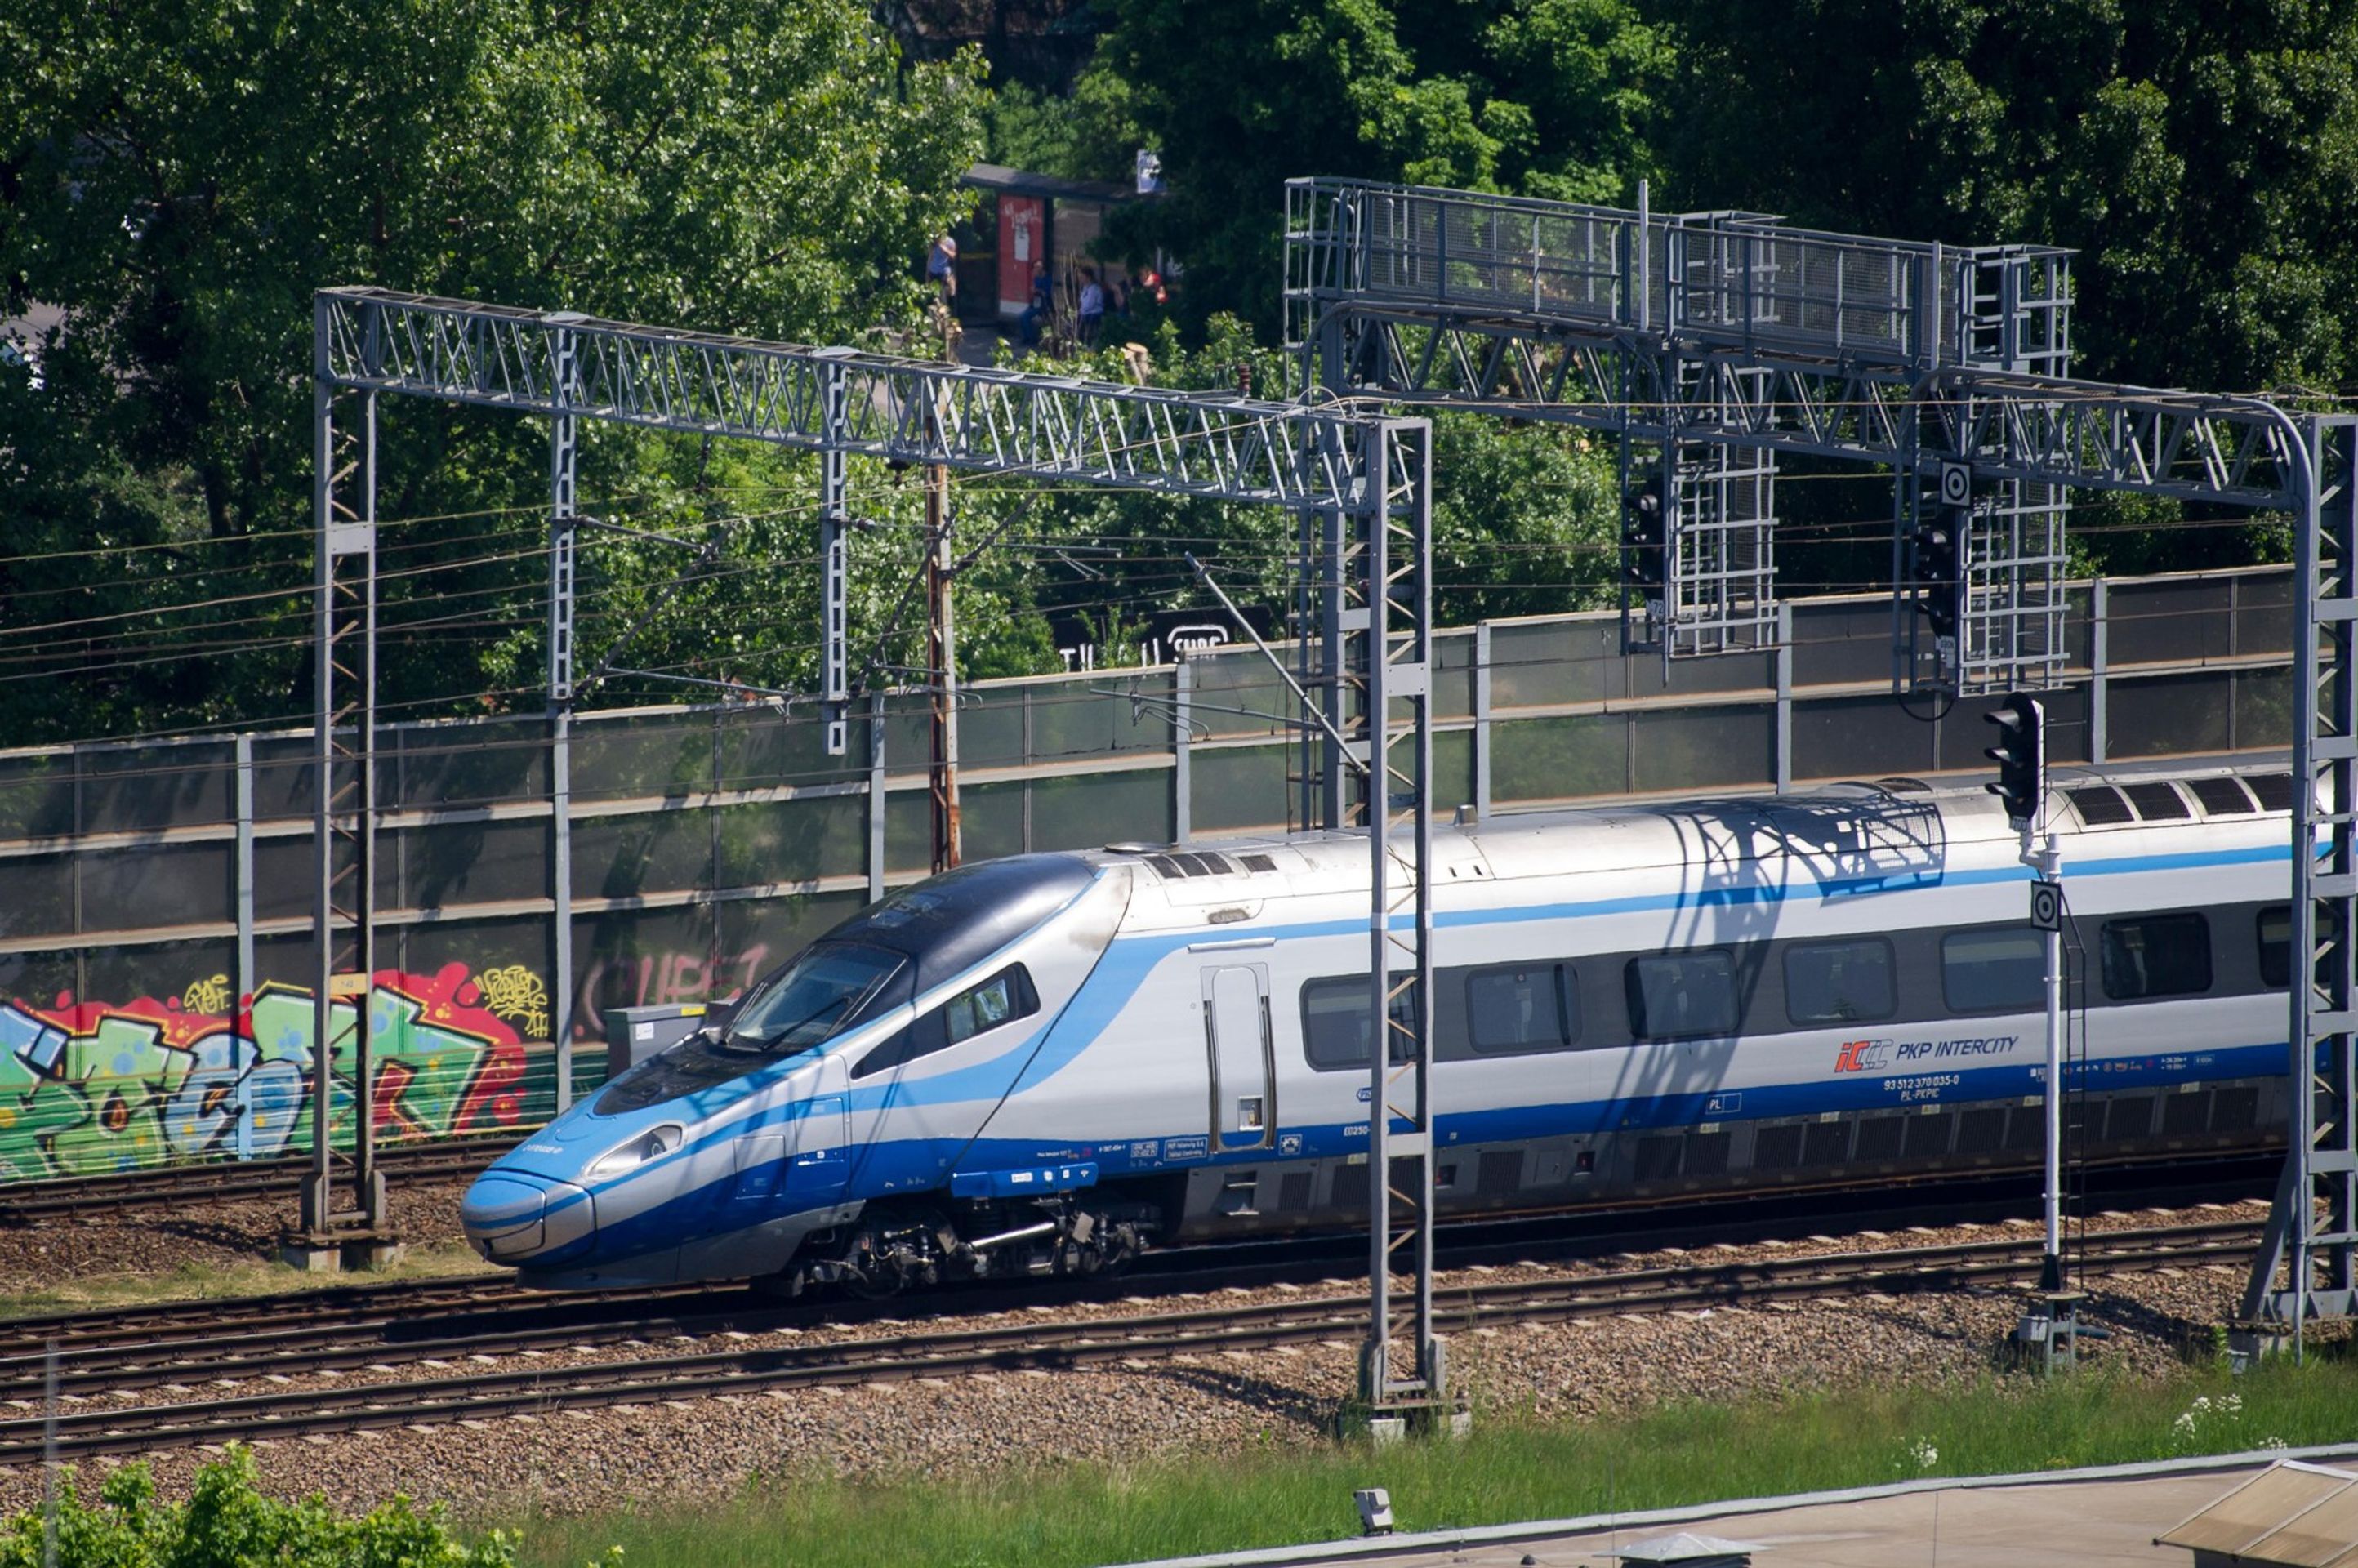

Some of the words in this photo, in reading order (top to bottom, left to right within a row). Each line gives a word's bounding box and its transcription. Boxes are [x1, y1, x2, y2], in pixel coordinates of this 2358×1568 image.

[1897, 1042, 1932, 1060] PKP
[1935, 1036, 2019, 1058] INTERCITY
[1883, 1080, 1896, 1091] 93
[1709, 1098, 1721, 1110] PL
